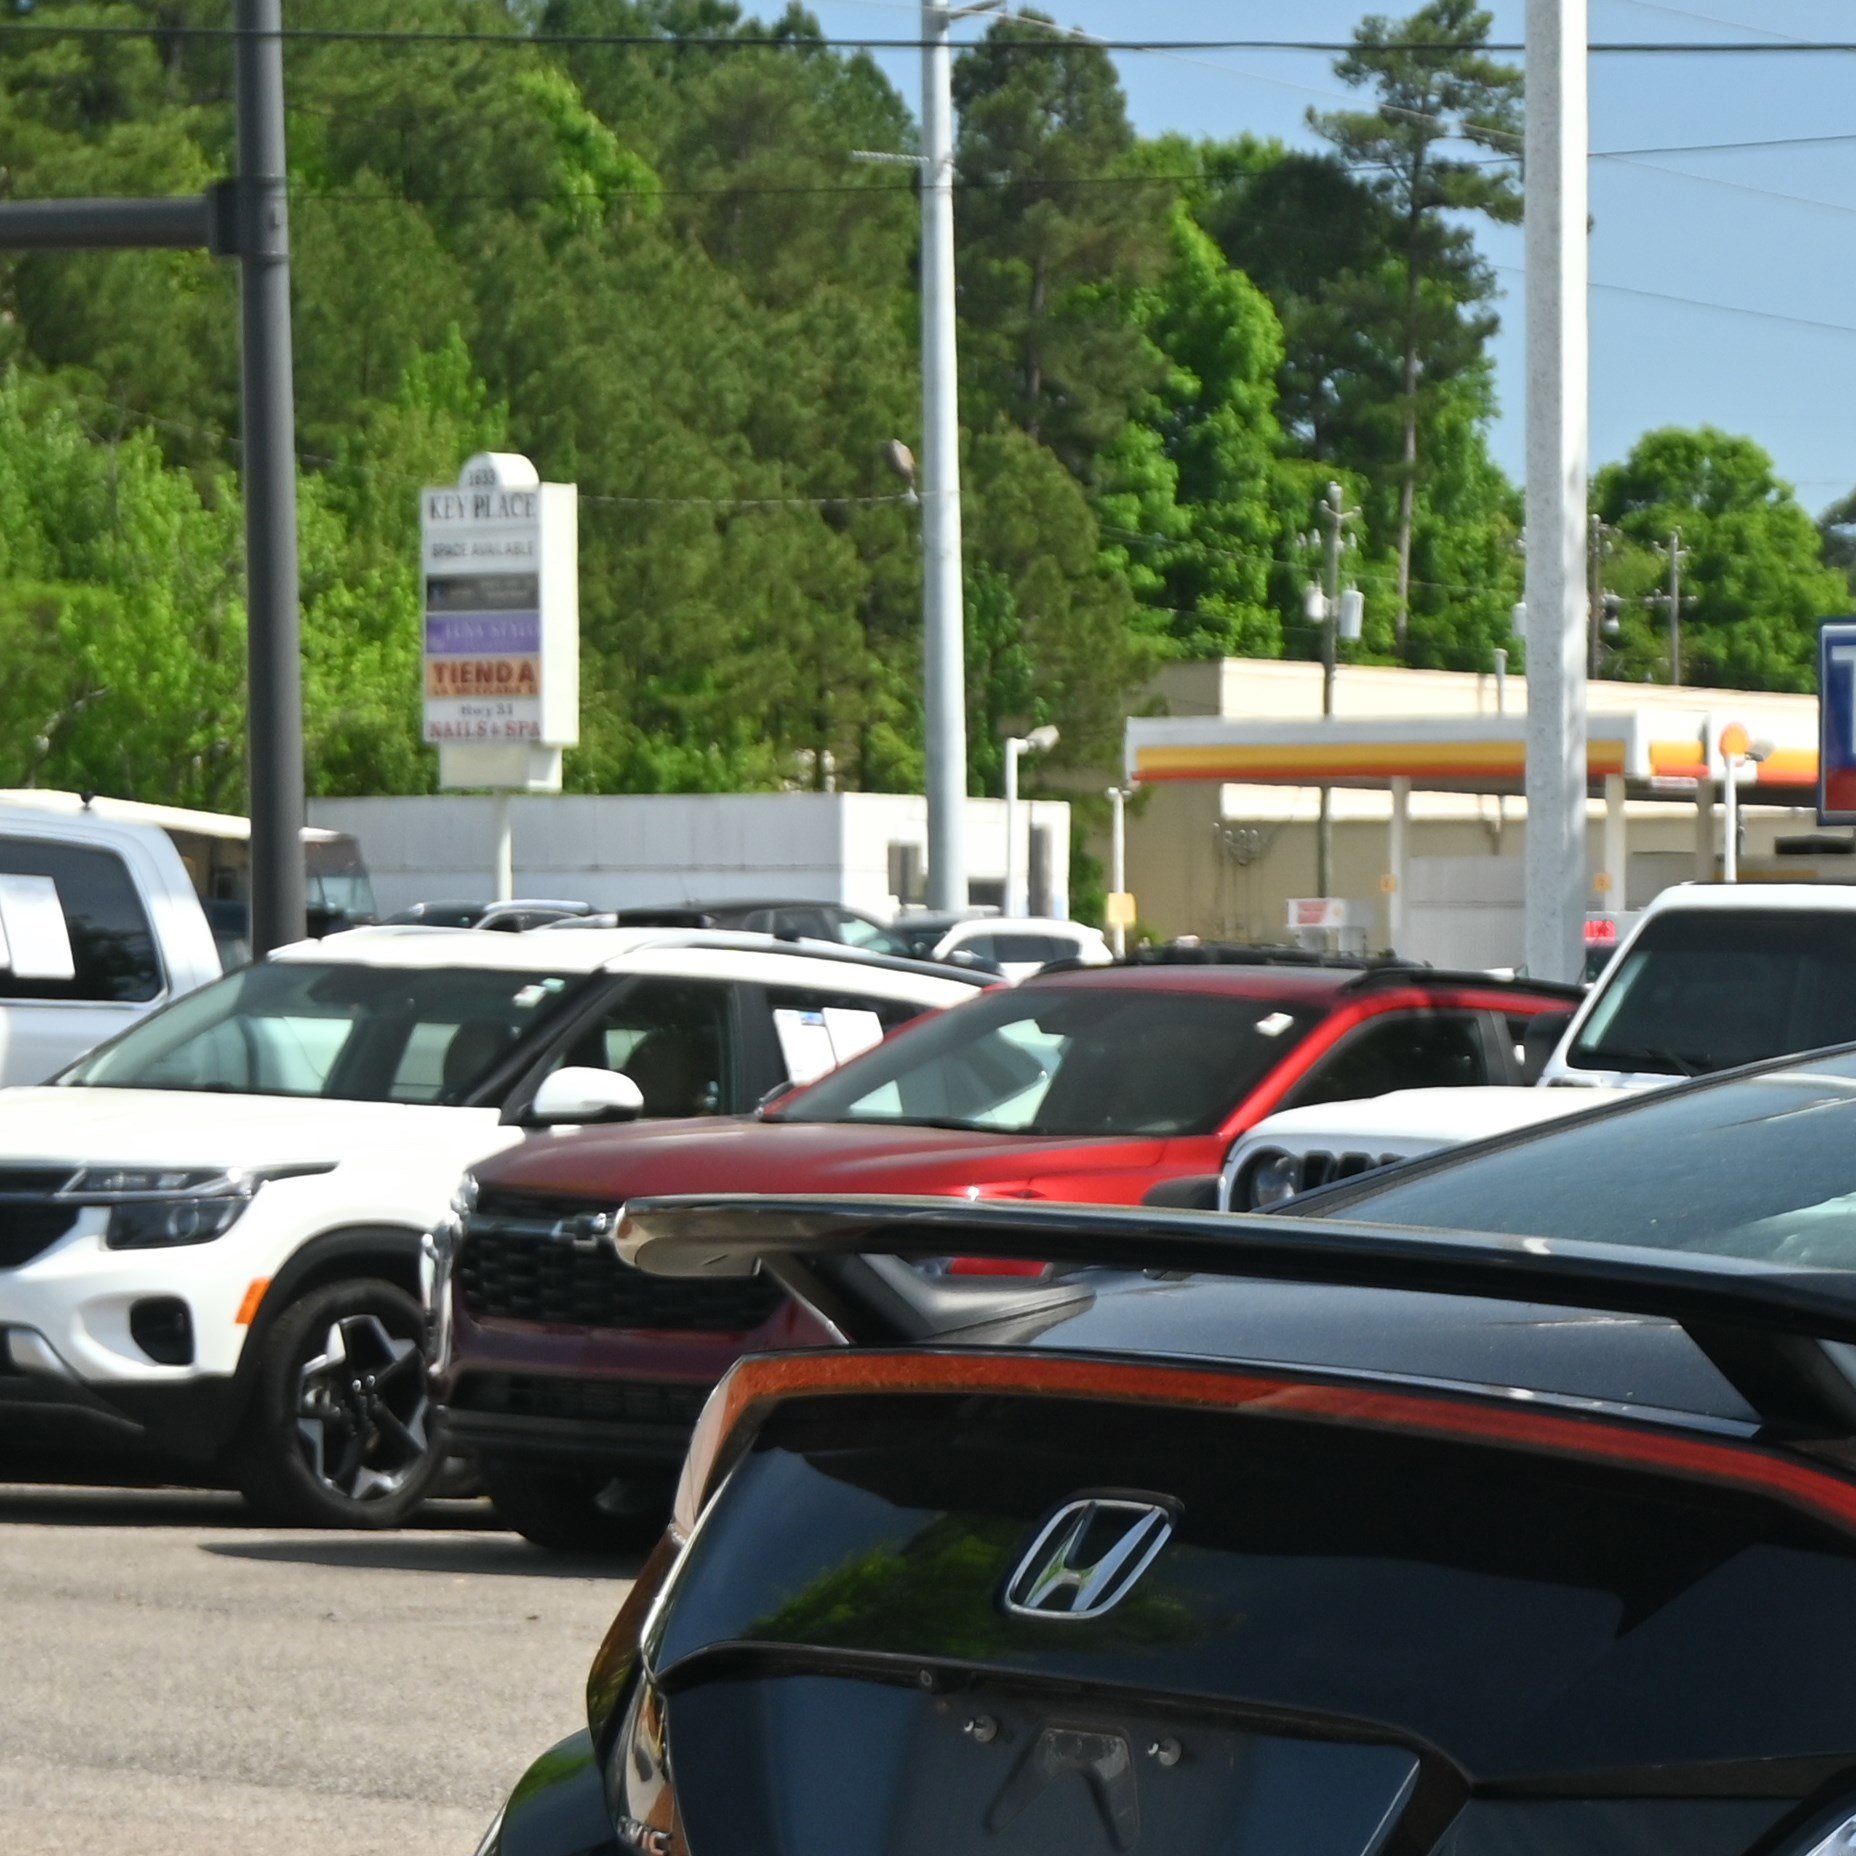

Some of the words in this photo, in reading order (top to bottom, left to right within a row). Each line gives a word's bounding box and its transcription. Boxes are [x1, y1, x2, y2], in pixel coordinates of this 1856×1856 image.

[430, 495, 467, 519] KEY
[474, 493, 537, 518] PLACE
[432, 543, 467, 557] SPACE
[471, 541, 534, 556] AVAILABLE
[433, 661, 535, 683] TIENDA
[461, 704, 492, 717] Hwy
[496, 703, 514, 715] 31
[430, 720, 487, 738] NAILS
[505, 720, 540, 738] SPA
